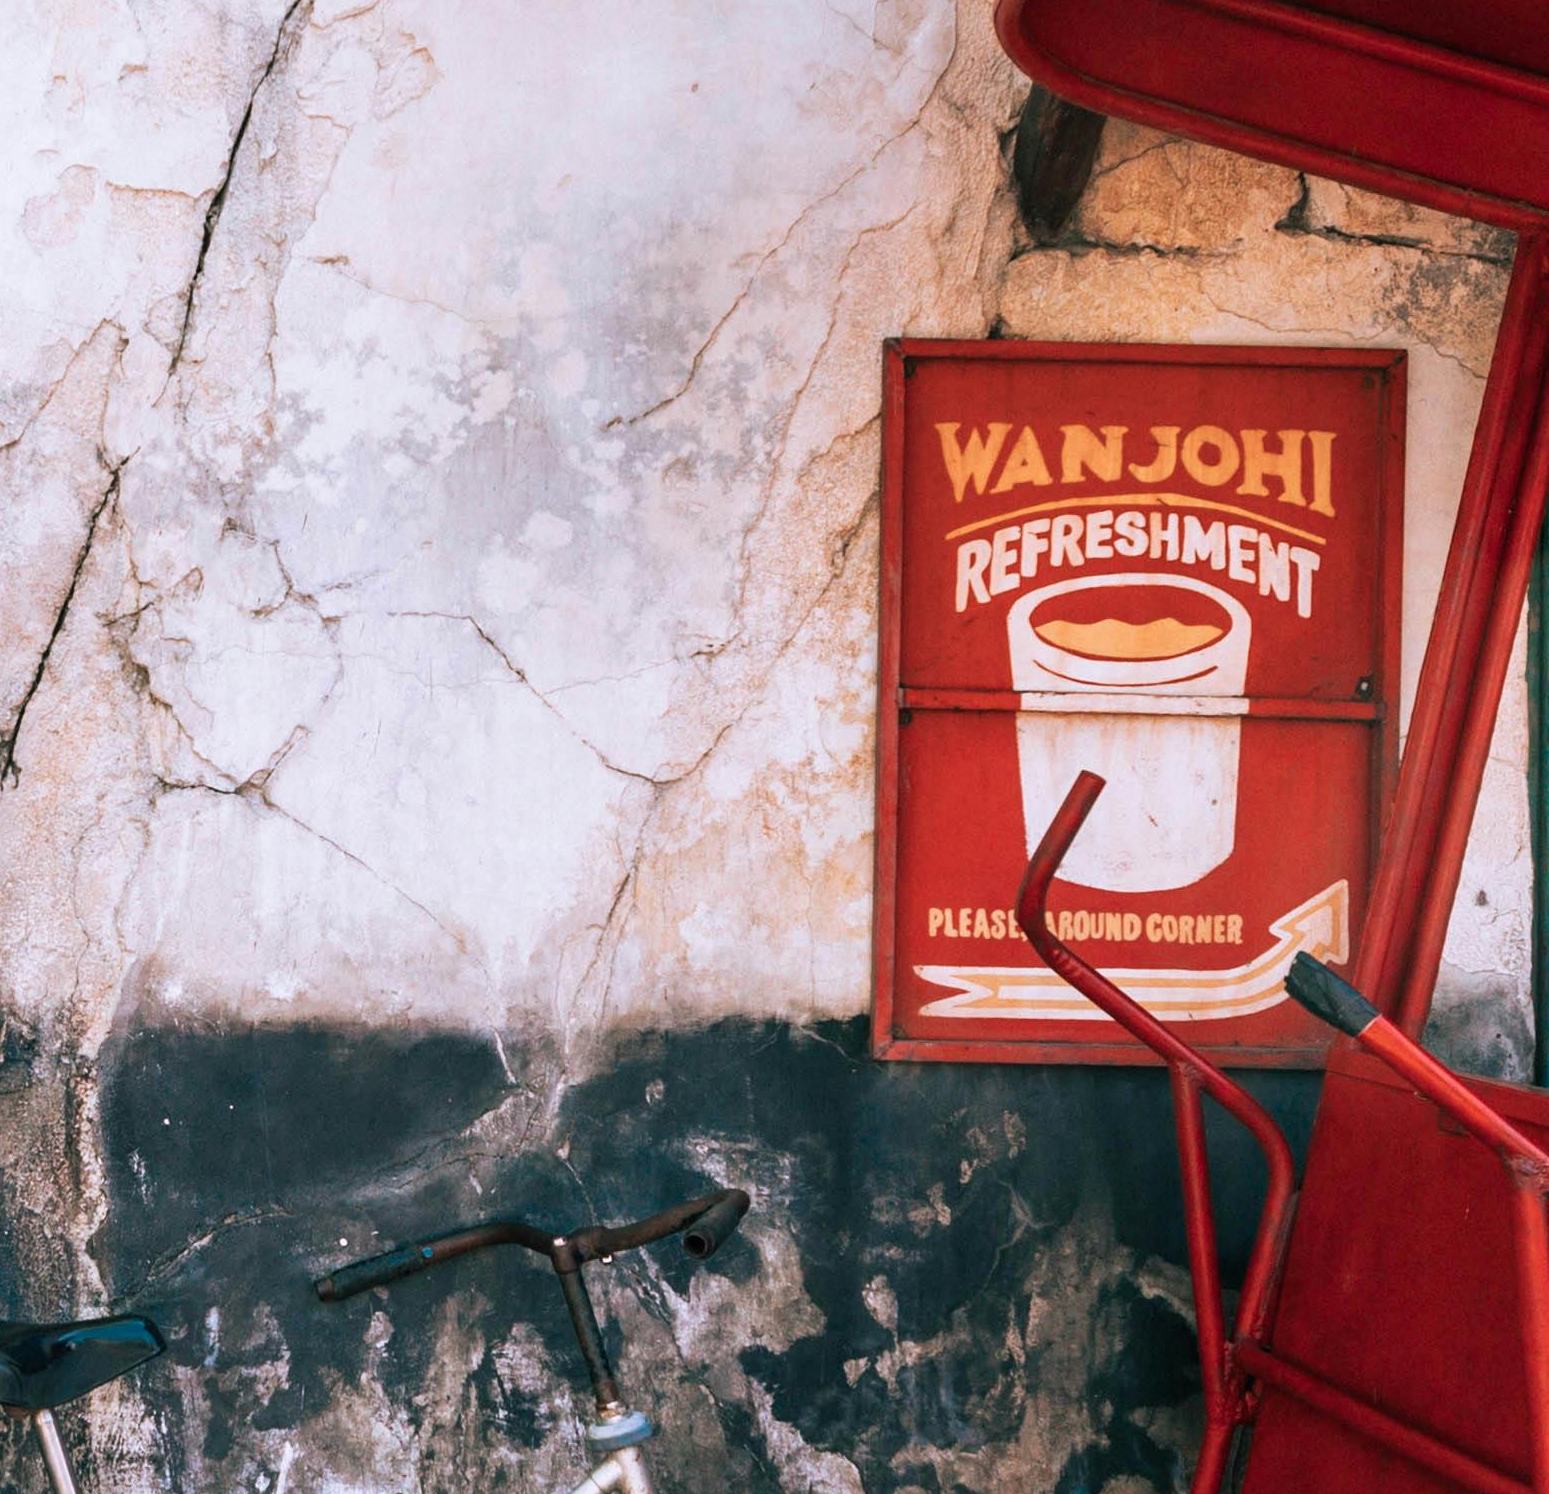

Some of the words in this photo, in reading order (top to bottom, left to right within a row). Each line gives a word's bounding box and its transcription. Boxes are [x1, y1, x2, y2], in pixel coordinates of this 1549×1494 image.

[935, 422, 1337, 517] WANJOHI
[954, 509, 1321, 619] REFRESHMENT
[1145, 912, 1244, 946] CORNER
